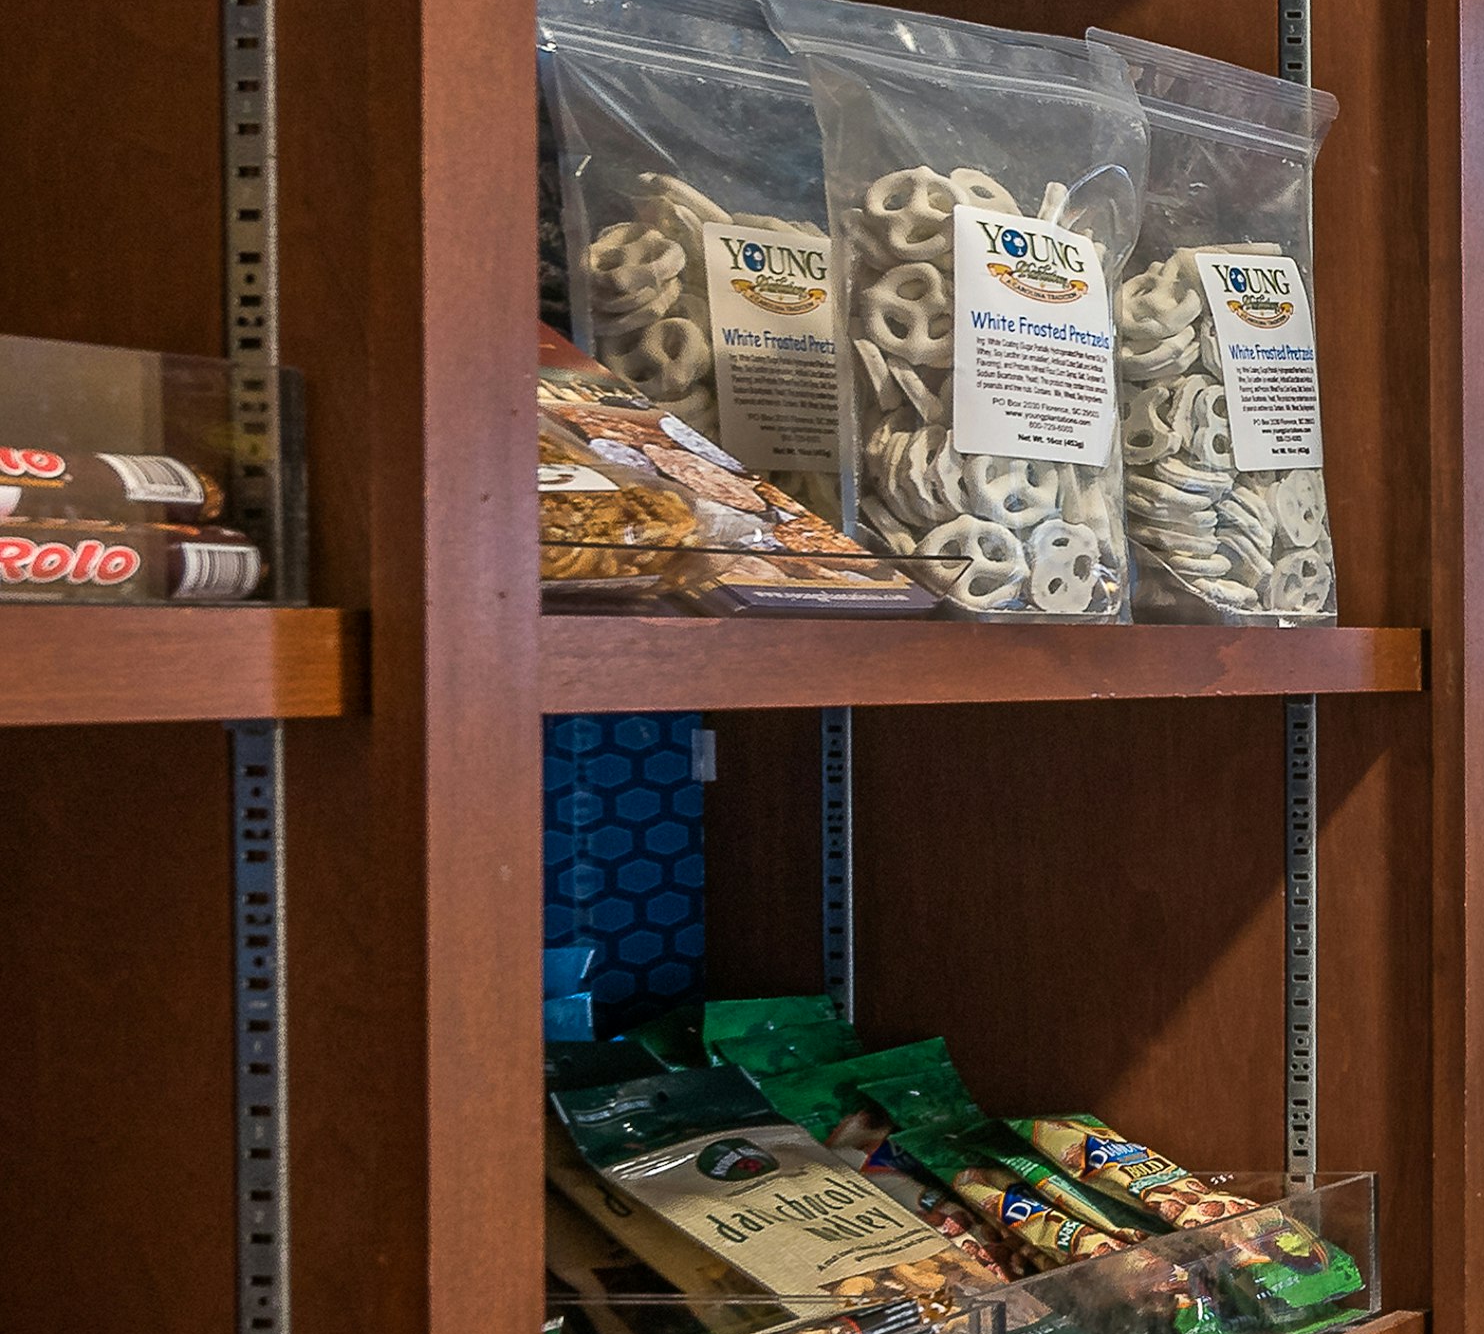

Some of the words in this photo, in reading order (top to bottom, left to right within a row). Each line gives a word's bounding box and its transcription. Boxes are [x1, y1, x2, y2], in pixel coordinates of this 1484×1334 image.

[720, 237, 828, 281] YOUNG
[976, 220, 1085, 273] YOUNG
[1212, 264, 1290, 296] YOUNG
[722, 328, 762, 348] White
[764, 331, 807, 353] Frosted
[971, 311, 1015, 333] White
[1019, 317, 1067, 342] Frosted
[1069, 325, 1110, 350] Pretzels
[1229, 344, 1256, 362] White
[1255, 344, 1287, 362] Frosted
[1126, 1159, 1168, 1179] BOLD
